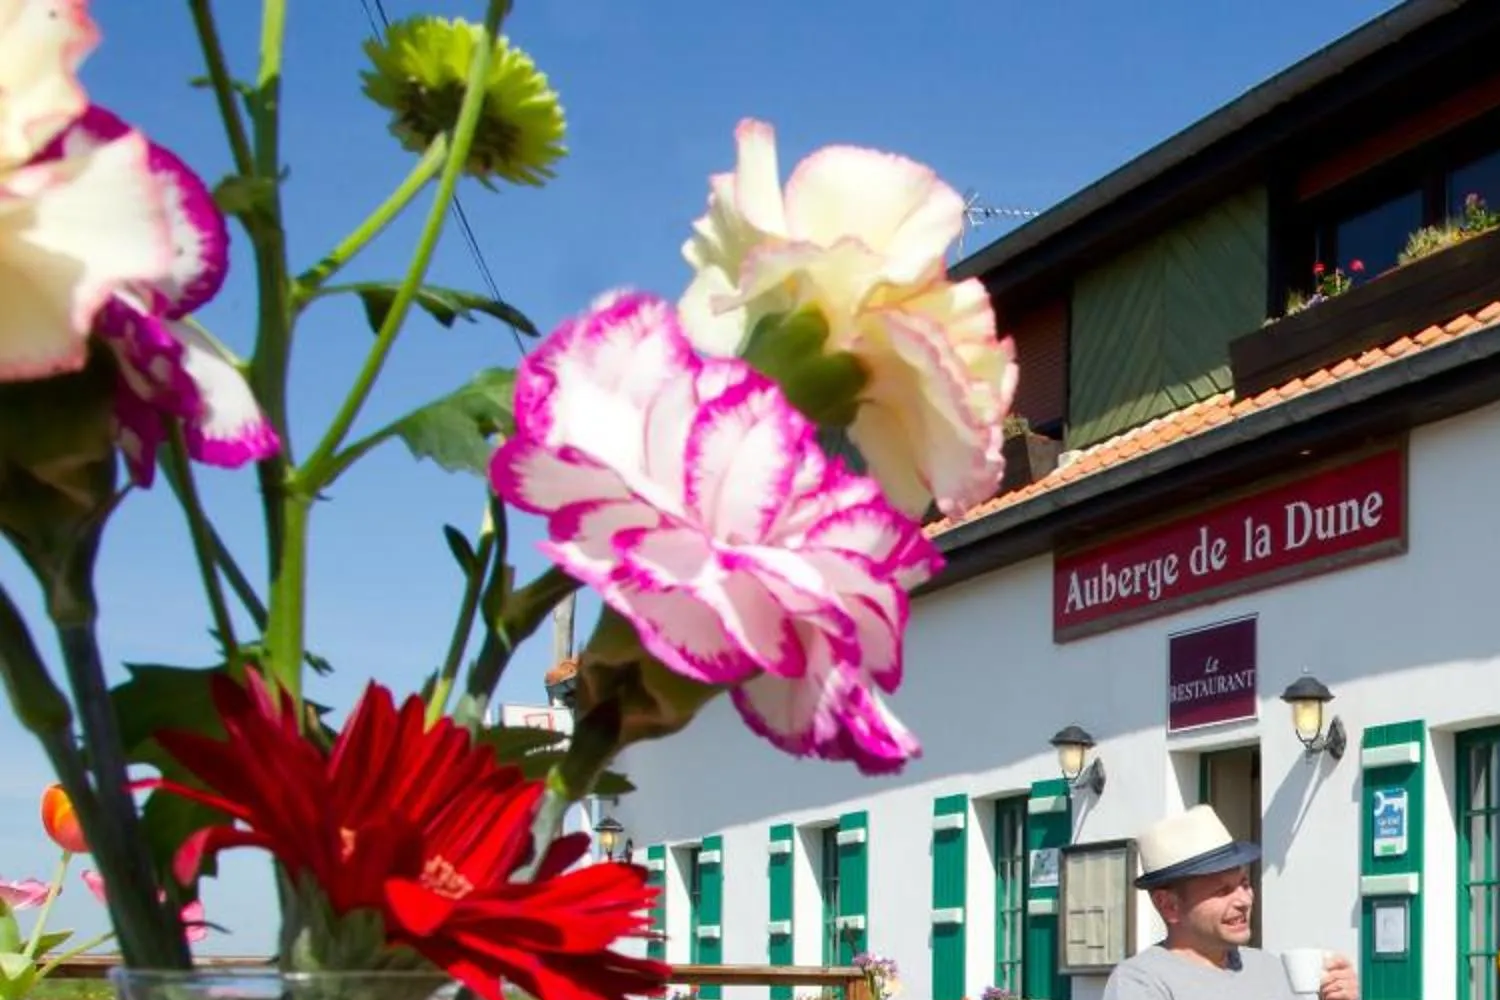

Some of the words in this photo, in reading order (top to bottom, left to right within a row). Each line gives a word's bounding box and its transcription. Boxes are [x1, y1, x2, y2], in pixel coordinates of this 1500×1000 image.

[1063, 553, 1180, 614] Auberge
[1189, 526, 1228, 576] de
[1243, 516, 1272, 563] la
[1283, 491, 1385, 551] Dune
[1170, 669, 1257, 702] RESTAURANT
